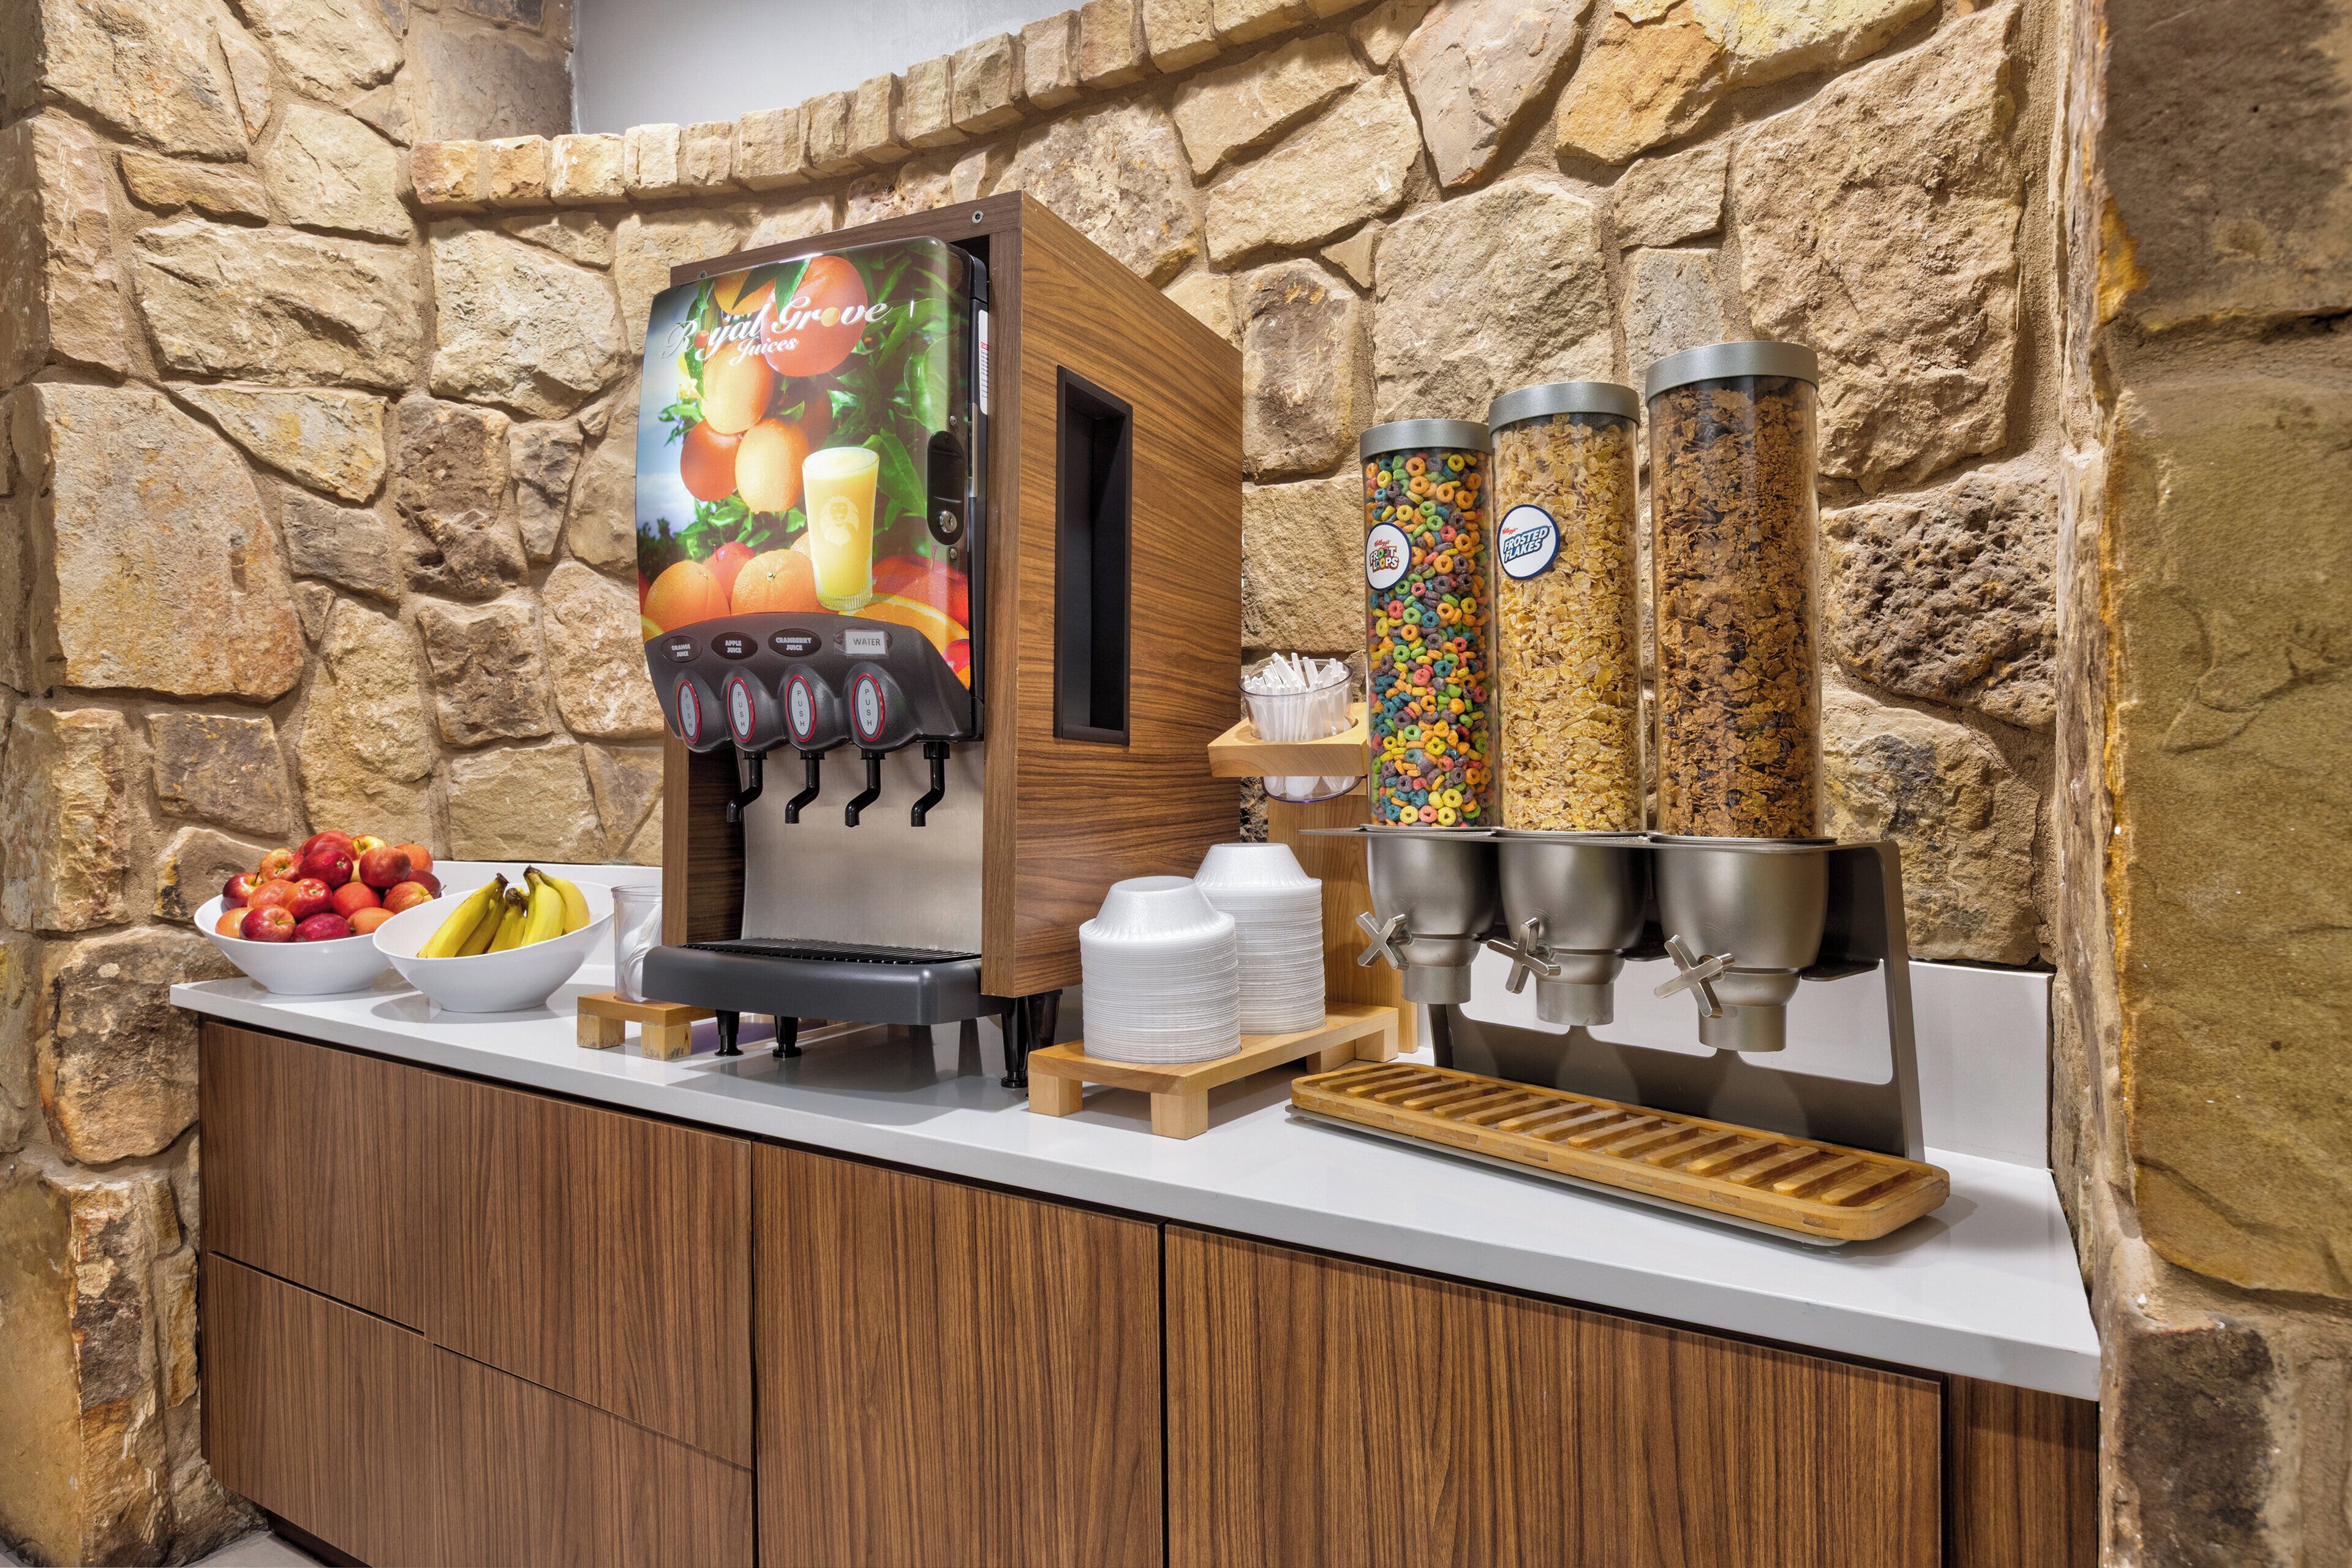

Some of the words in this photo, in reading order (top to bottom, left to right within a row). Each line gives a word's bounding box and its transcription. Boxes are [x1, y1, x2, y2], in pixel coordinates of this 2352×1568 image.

[661, 303, 771, 361] Royal
[771, 296, 893, 334] Grove
[729, 336, 799, 366] Juices
[1504, 527, 1549, 553] FROSTED
[1504, 539, 1542, 563] FLAKES
[1370, 546, 1396, 566] FROOT
[1373, 557, 1399, 572] LOOPS
[853, 638, 881, 646] WATER
